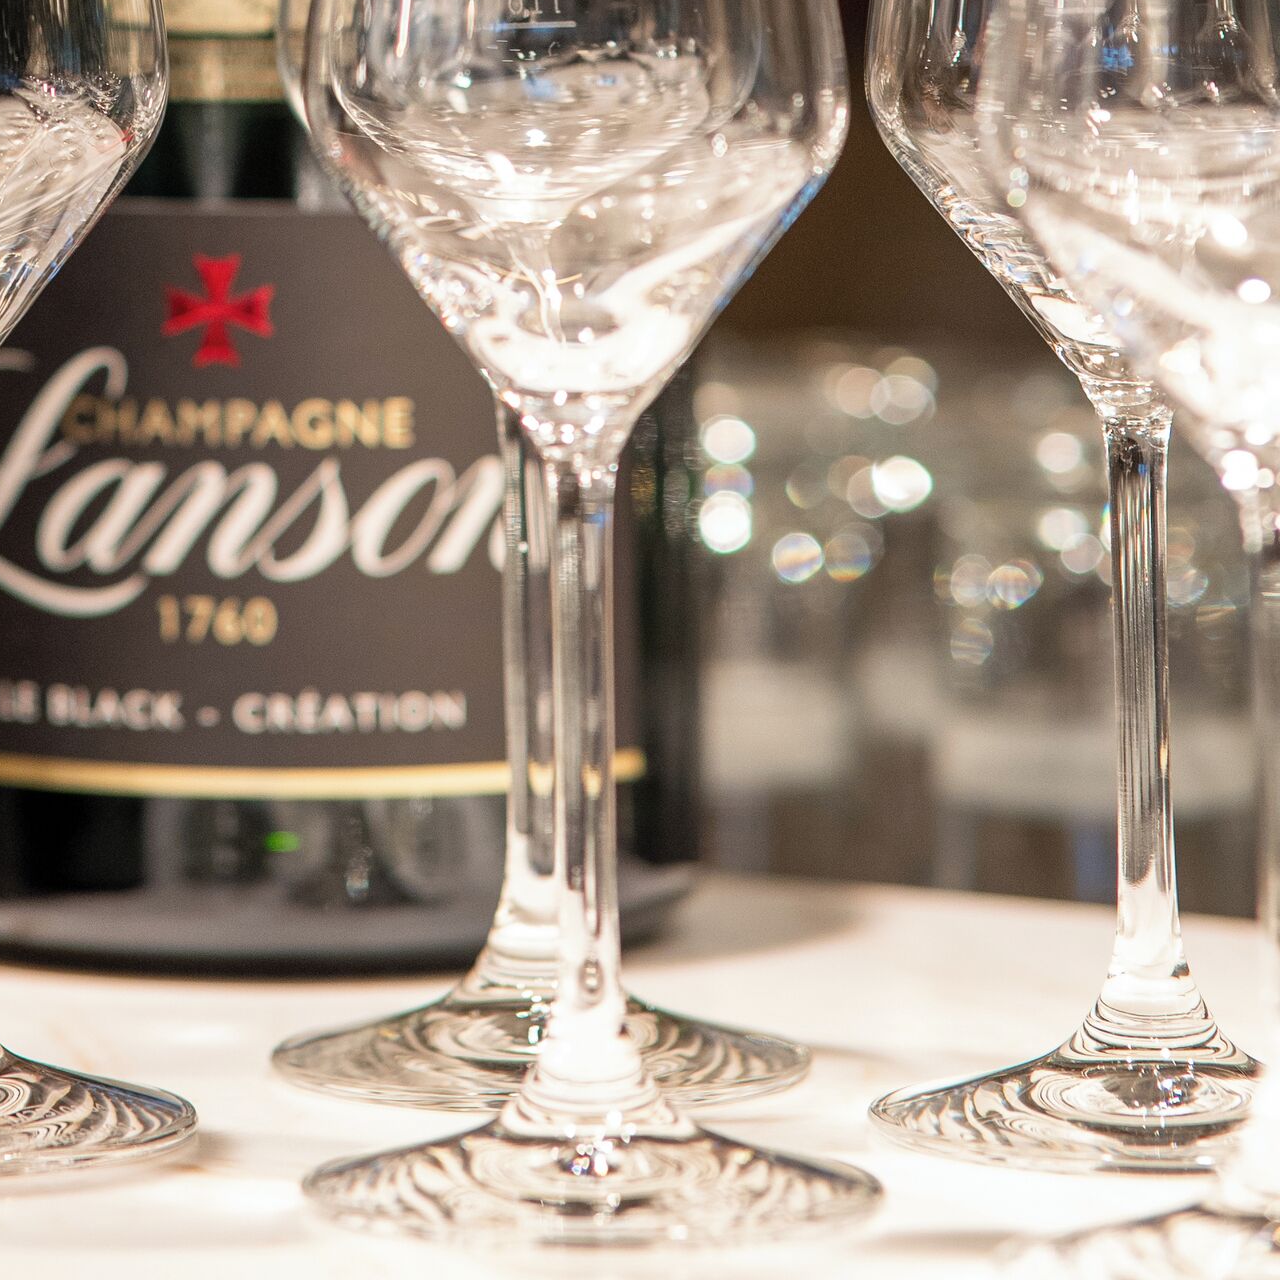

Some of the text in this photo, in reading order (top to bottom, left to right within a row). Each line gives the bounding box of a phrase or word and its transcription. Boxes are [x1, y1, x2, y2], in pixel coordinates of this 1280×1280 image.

[62, 393, 417, 450] CHAMPAGNE
[157, 595, 279, 646] 1760
[46, 681, 185, 732] BLACK
